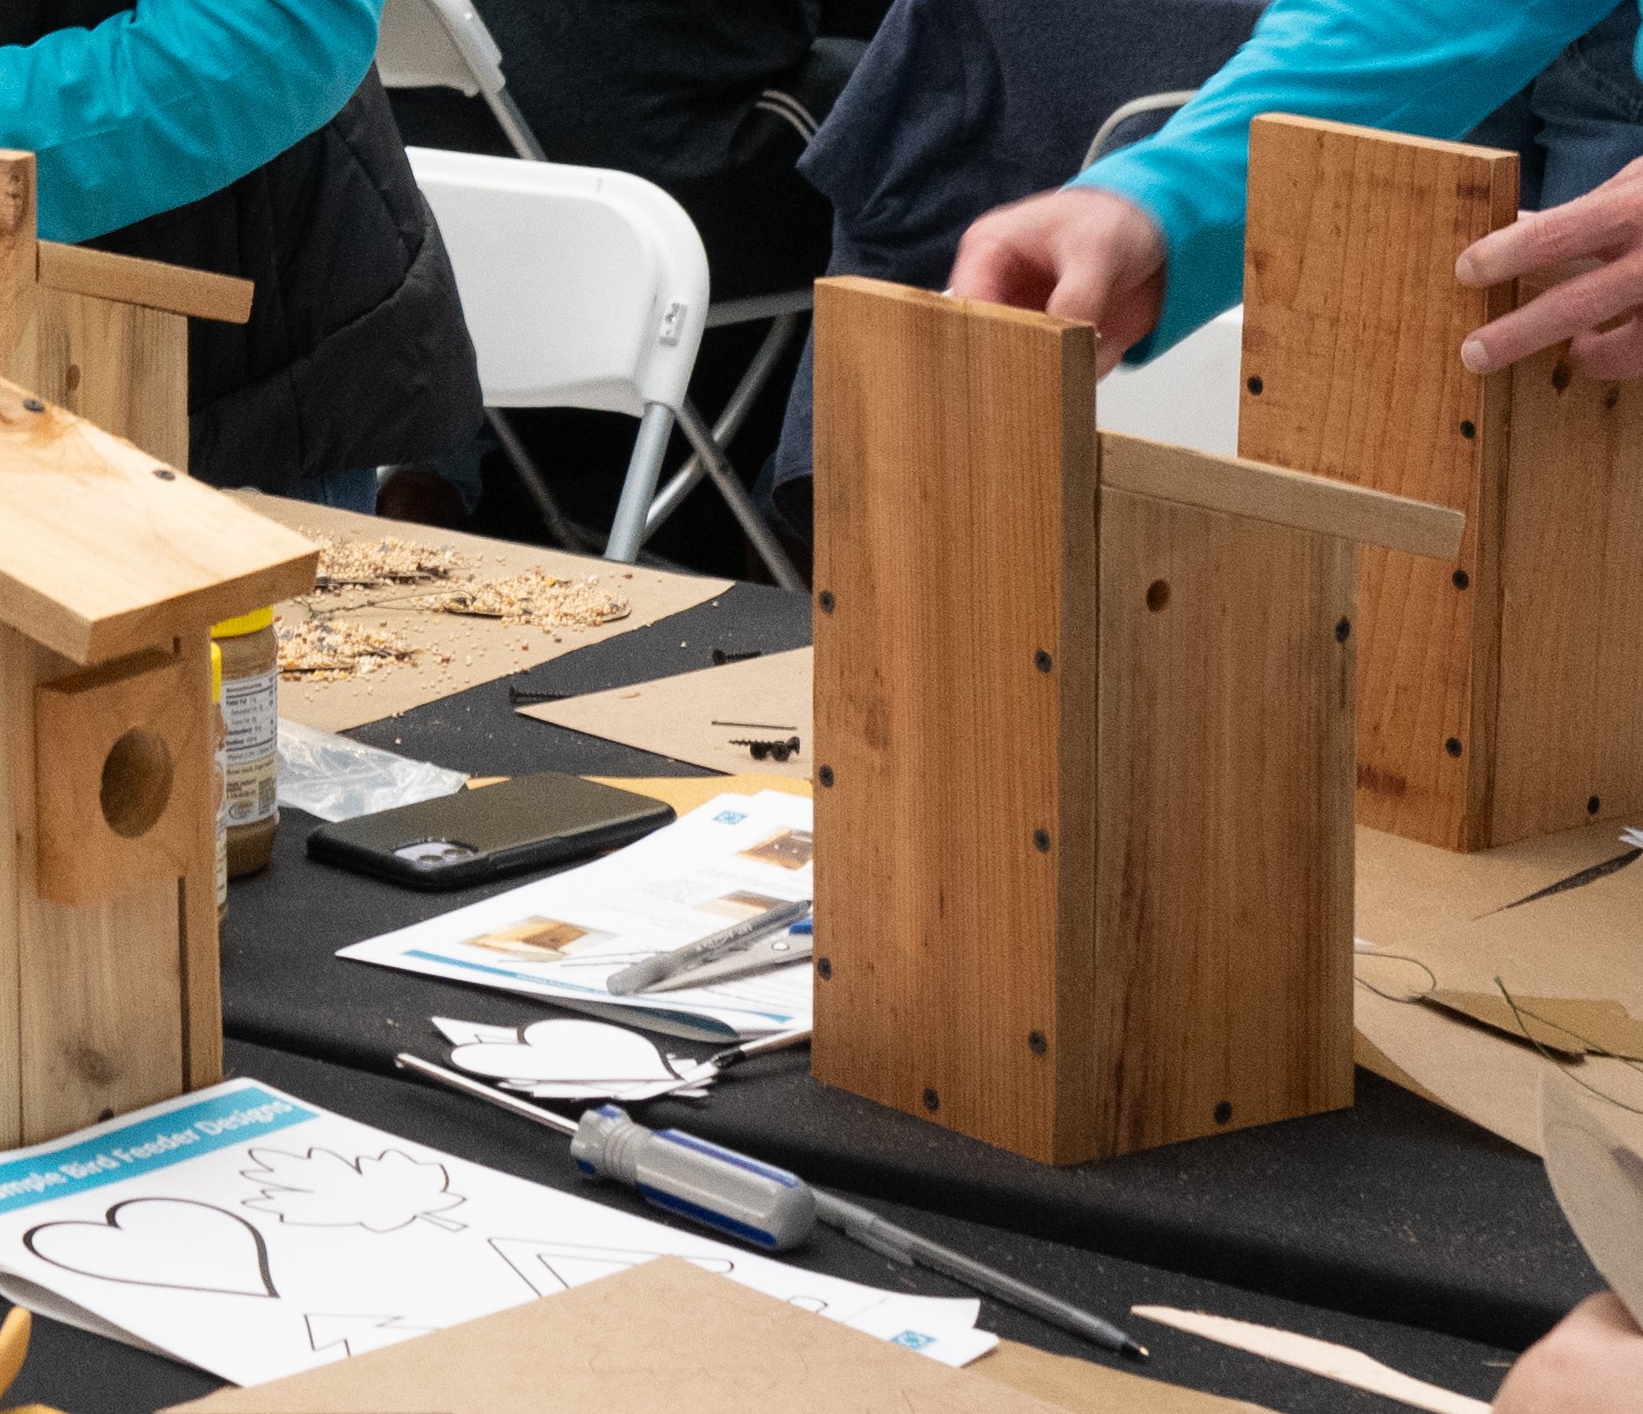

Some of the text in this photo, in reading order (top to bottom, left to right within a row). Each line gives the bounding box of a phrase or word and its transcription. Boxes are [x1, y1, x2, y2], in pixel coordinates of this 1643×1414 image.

[61, 1152, 120, 1179] Bird
[114, 1128, 199, 1169] Feeder
[195, 1099, 295, 1136] Designs
